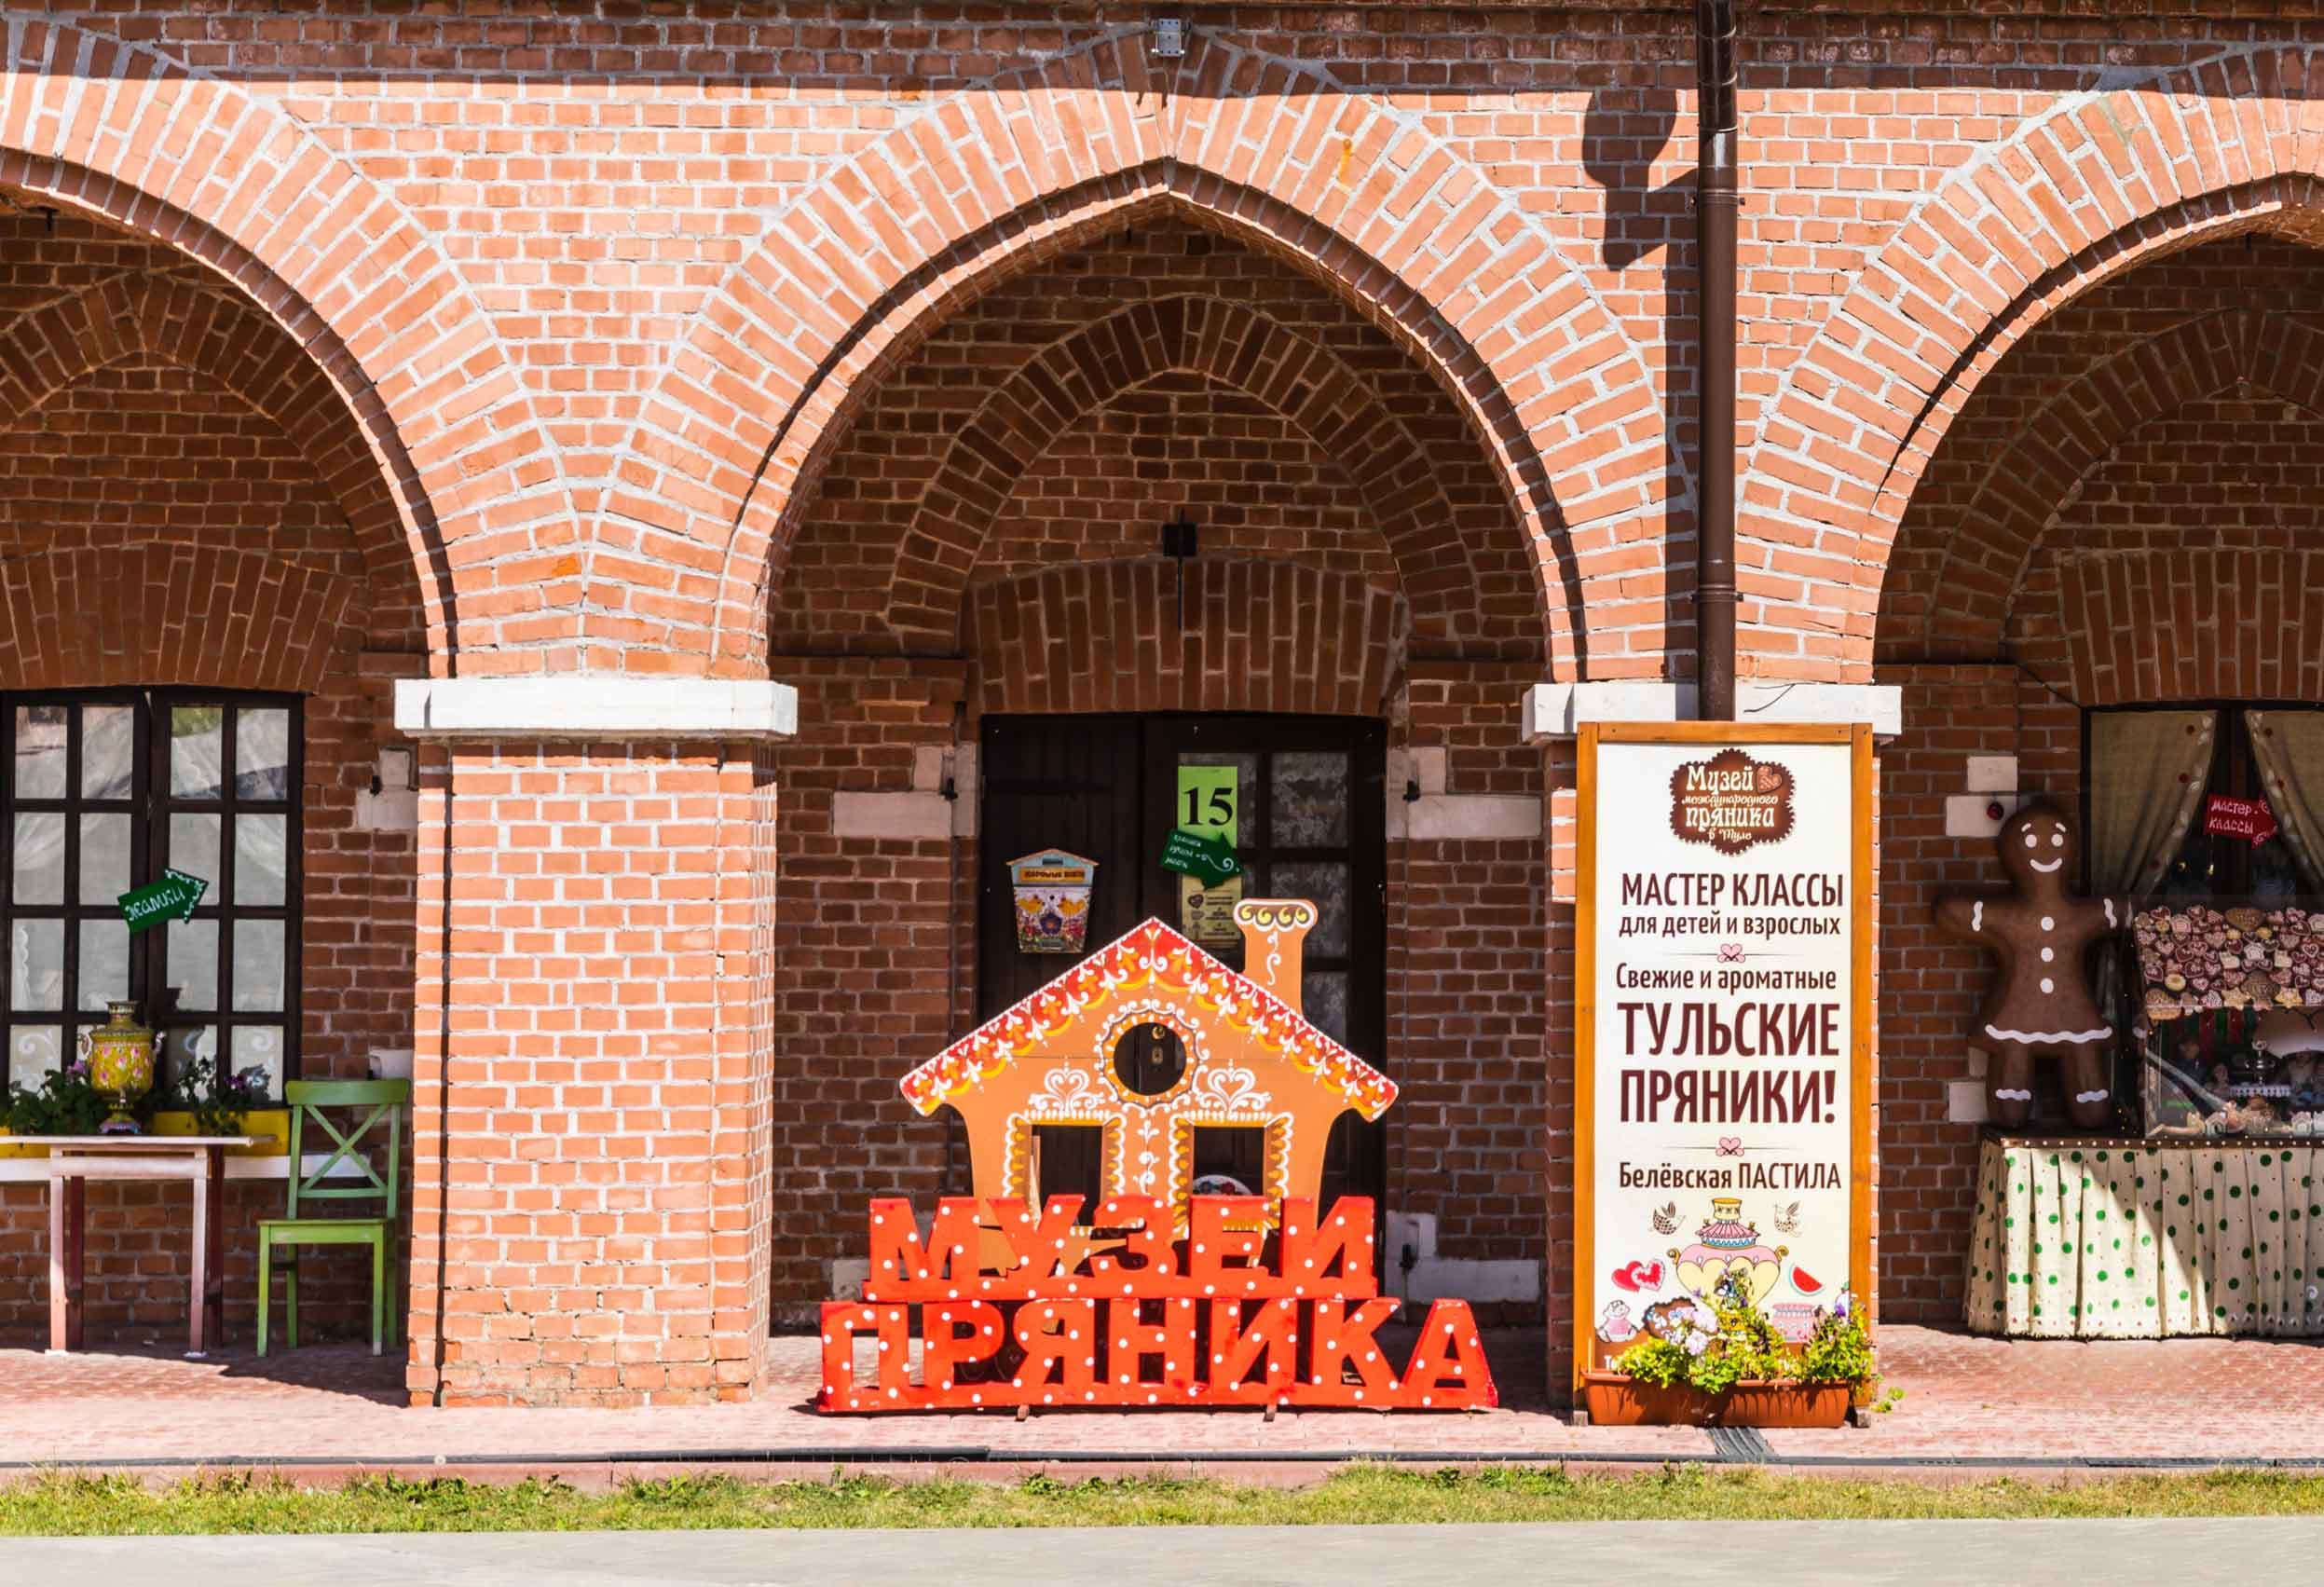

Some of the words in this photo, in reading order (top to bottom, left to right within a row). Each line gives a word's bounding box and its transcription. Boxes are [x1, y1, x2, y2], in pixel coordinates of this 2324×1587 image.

[1686, 765, 1754, 795] Музей
[1182, 787, 1233, 826] 15
[1681, 793, 1779, 807] международного
[1685, 807, 1775, 832] пряника
[1621, 872, 1726, 907] МАСТЕР
[1731, 873, 1843, 908] КЛАССЫ
[1619, 915, 1657, 937] для
[1661, 910, 1721, 938] детей
[1726, 916, 1738, 935] и
[1743, 916, 1841, 940] взрослых
[1616, 962, 1694, 989] Свежие
[1700, 969, 1712, 990] и
[1717, 969, 1837, 996] ароматные
[1617, 1001, 1840, 1057] ТУЛЬСКИЕ
[1620, 1069, 1837, 1124] ПРЯНИКИ!
[1619, 1161, 1732, 1189] Белёвская
[1738, 1162, 1842, 1190] ПАСТИЛА
[820, 1297, 1500, 1410] ПРЯНИКА
